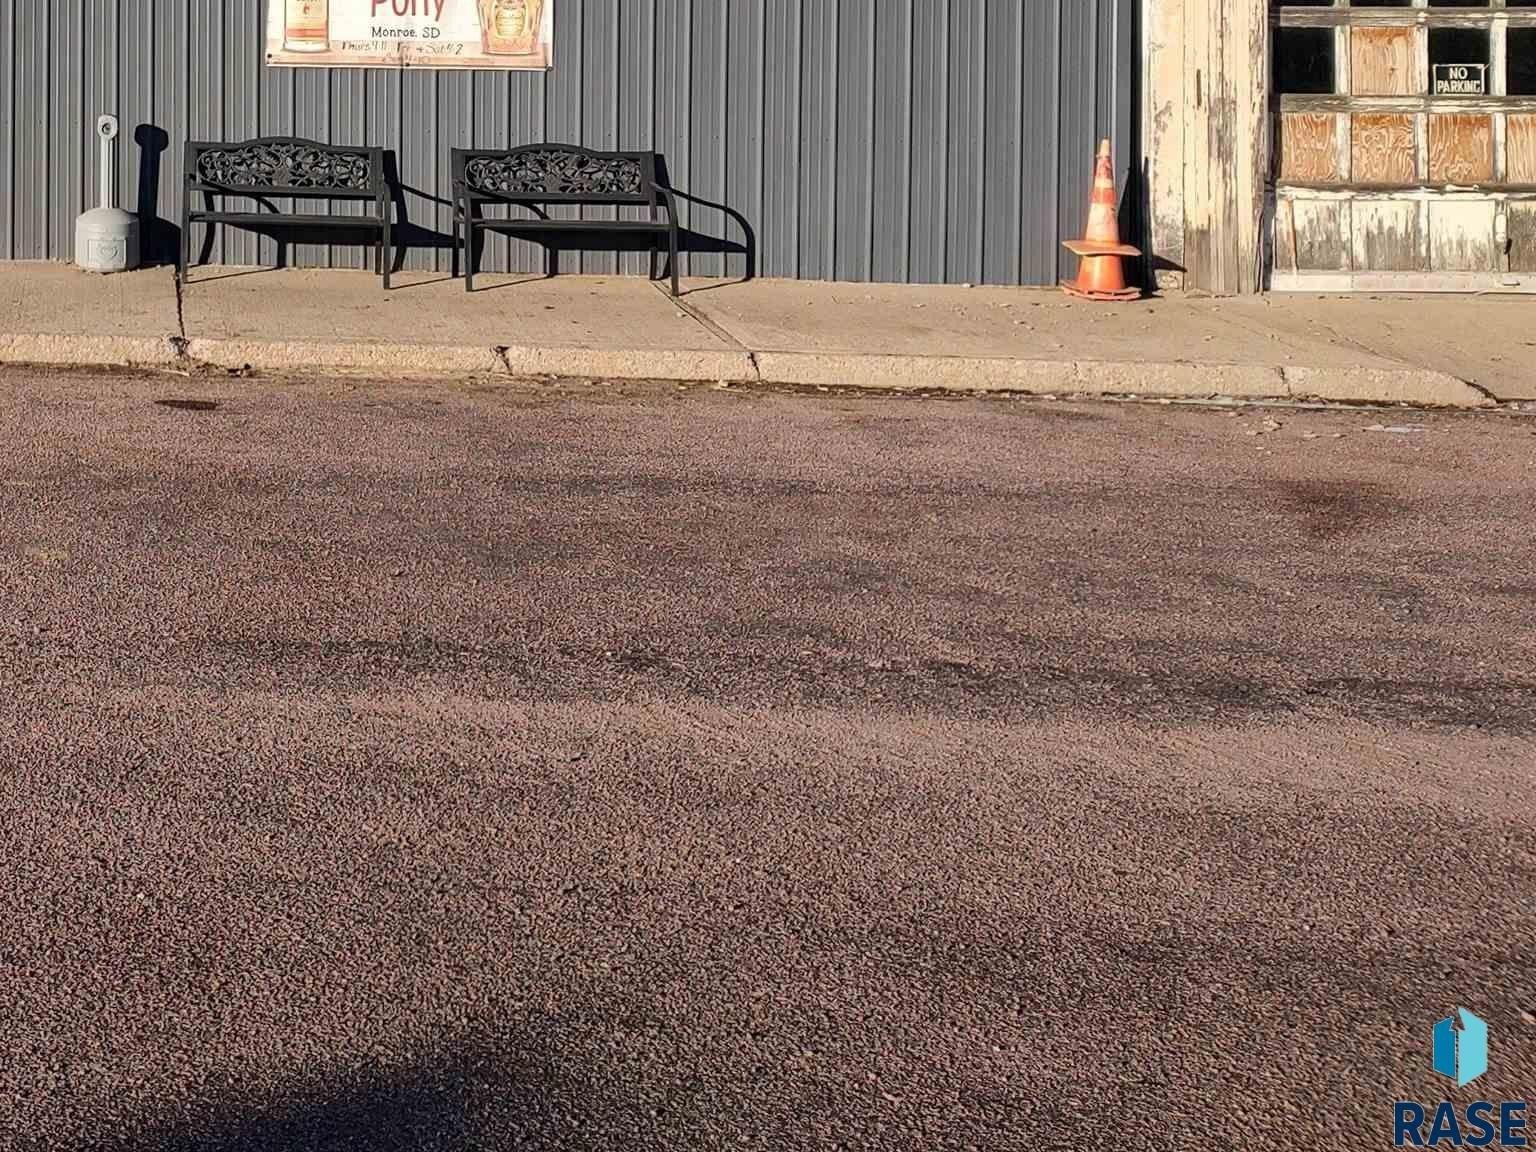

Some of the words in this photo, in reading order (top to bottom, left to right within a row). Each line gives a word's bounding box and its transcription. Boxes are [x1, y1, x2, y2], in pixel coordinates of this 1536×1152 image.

[422, 26, 441, 39] SD
[1449, 67, 1468, 79] NO
[1437, 80, 1481, 92] PARKING
